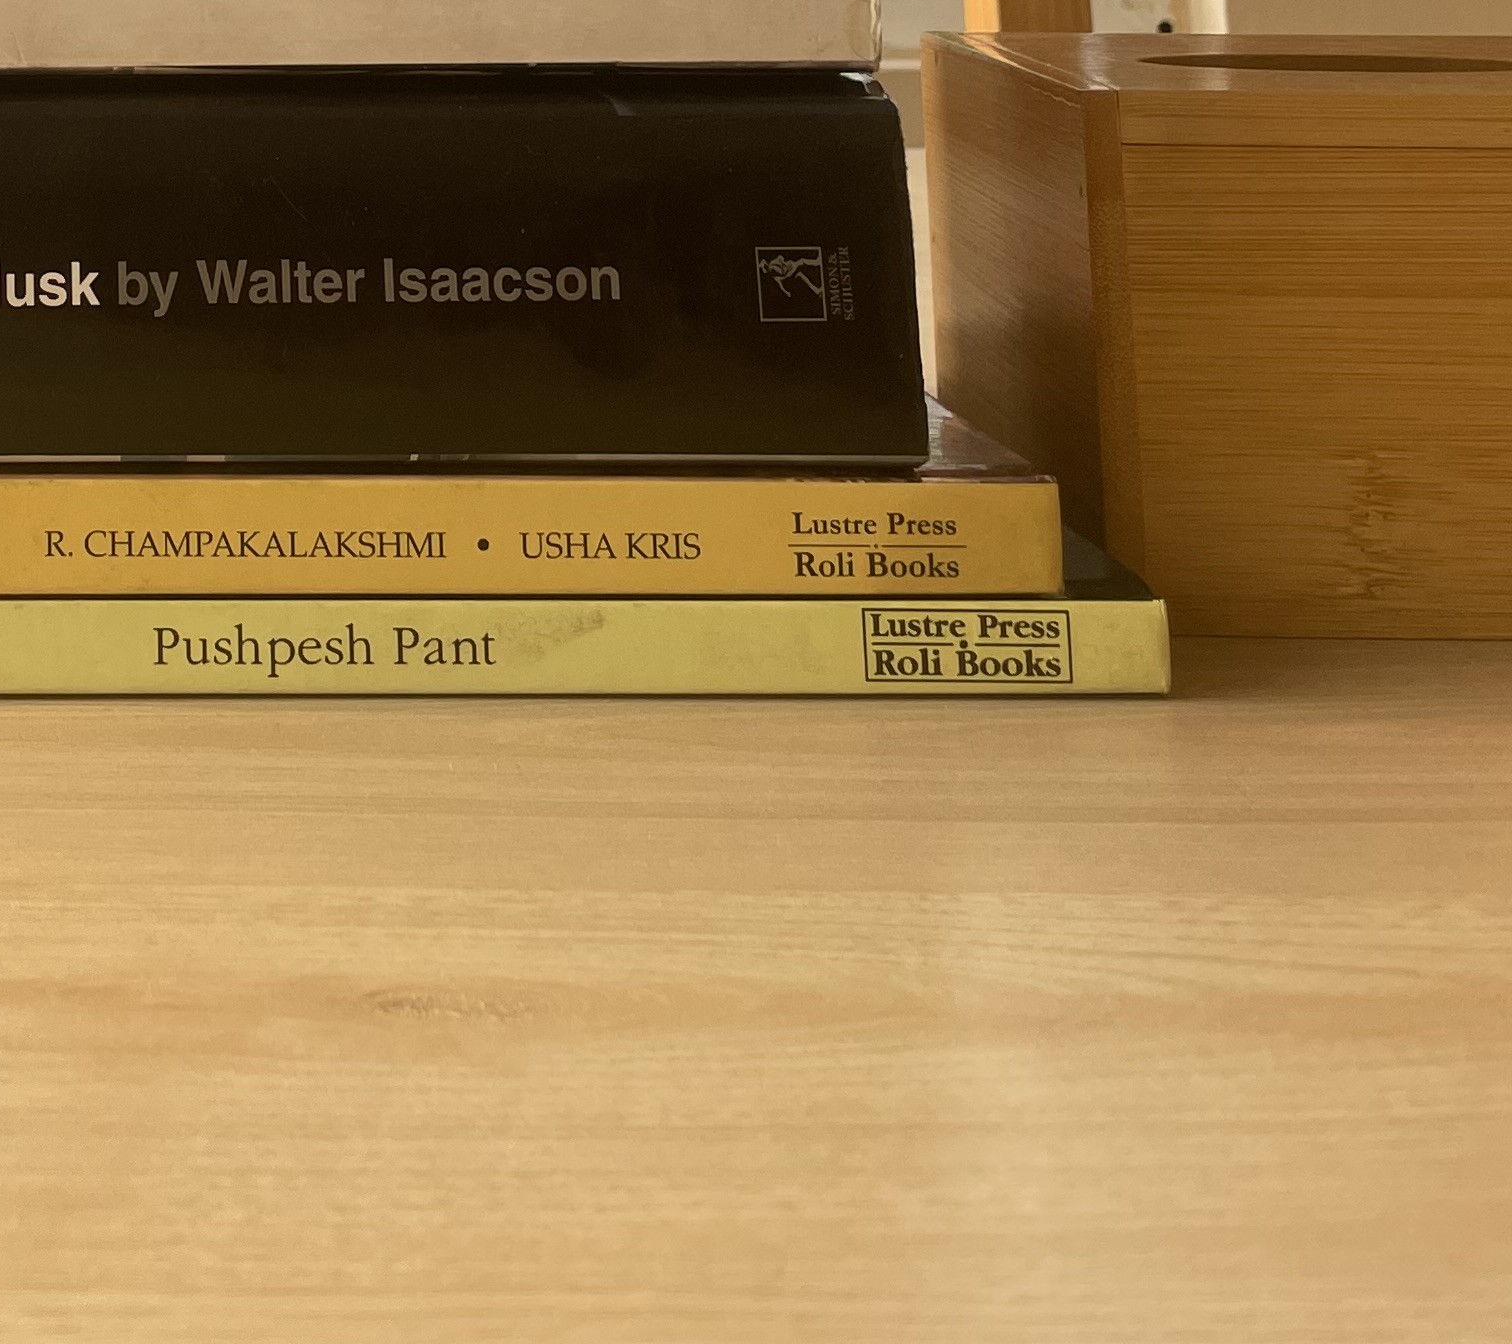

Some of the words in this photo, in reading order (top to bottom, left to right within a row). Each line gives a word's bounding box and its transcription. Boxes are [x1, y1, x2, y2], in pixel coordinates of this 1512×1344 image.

[118, 261, 178, 317] by
[196, 259, 365, 304] Walter
[384, 258, 620, 302] Isaacson
[792, 512, 876, 534] Lustre
[887, 513, 956, 535] Press
[45, 531, 72, 557] R.
[85, 531, 446, 558] CHAMPAKALAKSHMI
[519, 532, 617, 559] USHA
[625, 533, 700, 559] KRIS
[794, 552, 854, 577] Roli
[867, 553, 959, 577] Books
[871, 614, 966, 638] Lustre
[978, 614, 1061, 639] Press
[153, 623, 374, 677] Pushpesh
[393, 628, 496, 665] Pant
[873, 650, 944, 676] Roli
[956, 648, 1061, 678] Books
